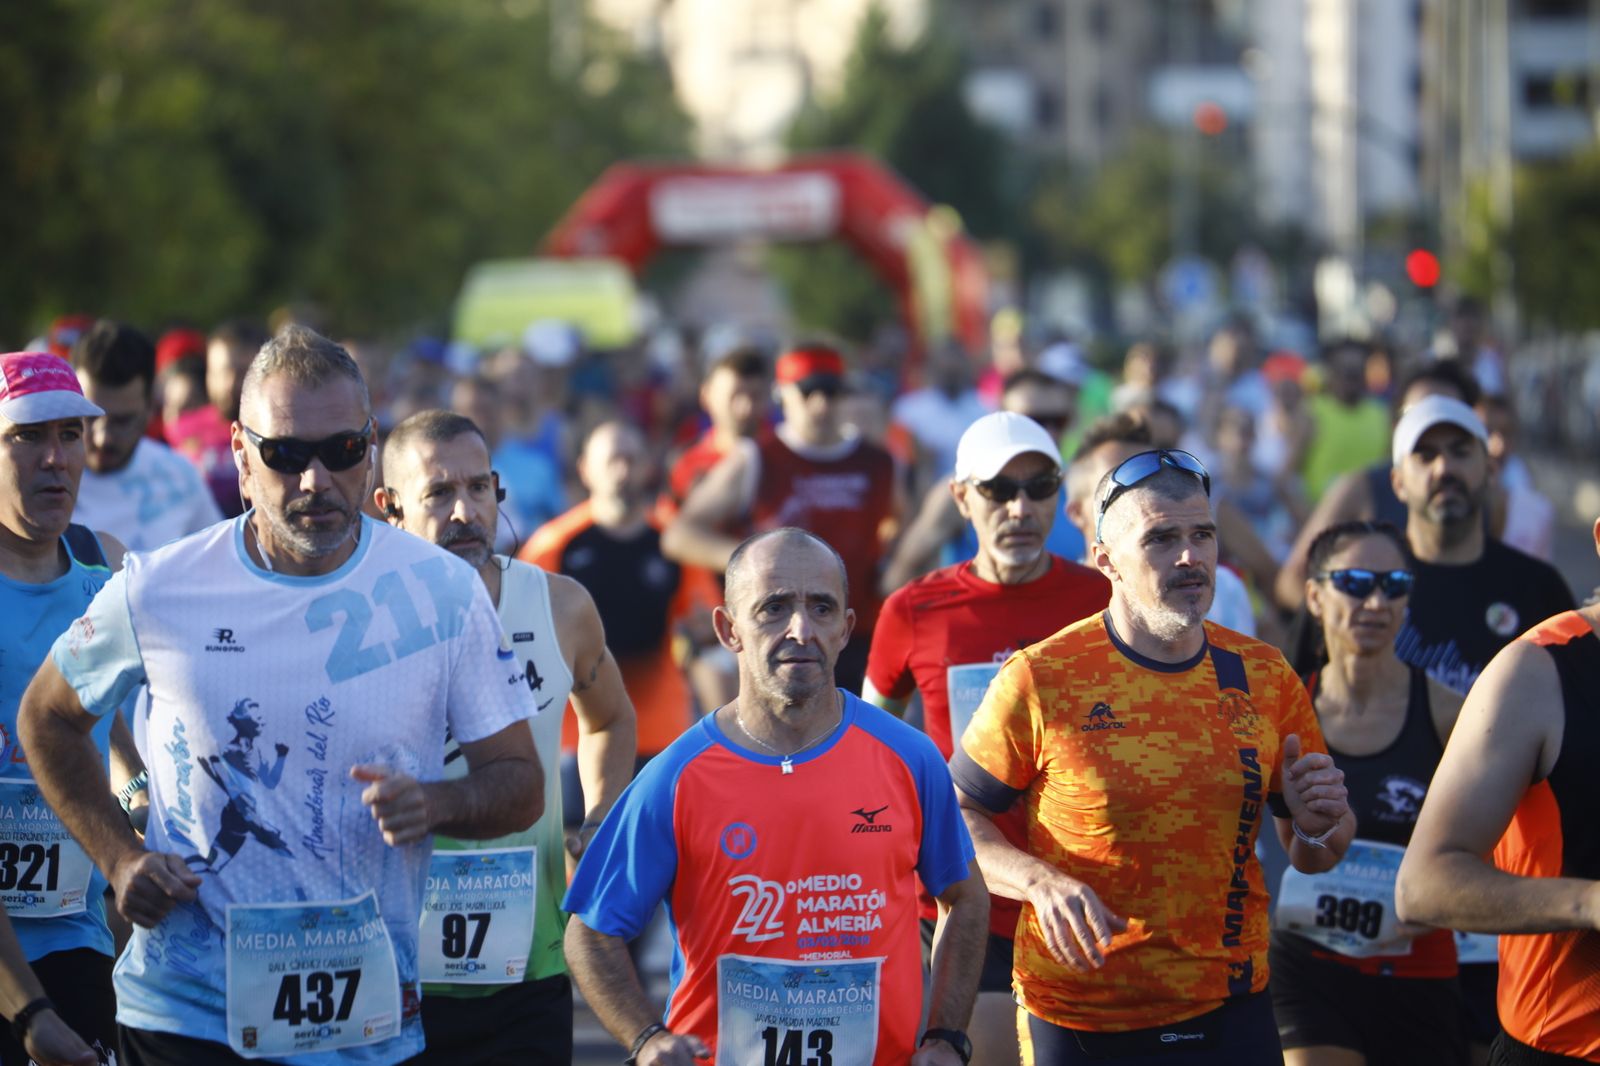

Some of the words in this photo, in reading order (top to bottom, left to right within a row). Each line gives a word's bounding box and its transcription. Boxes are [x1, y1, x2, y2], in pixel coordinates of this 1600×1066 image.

[1221, 747, 1264, 948] MARCHENA
[0, 842, 61, 892] 321
[457, 869, 532, 891] MARATÓN
[797, 873, 863, 894] MEDIO
[235, 932, 298, 950] MEDIA
[304, 918, 384, 947] MARATÓN
[796, 911, 883, 935] ALMERÍA
[271, 967, 363, 1027] 437
[725, 980, 780, 1003] MEDIA
[786, 981, 873, 1005] MARATÓN
[761, 1026, 834, 1066] 143
